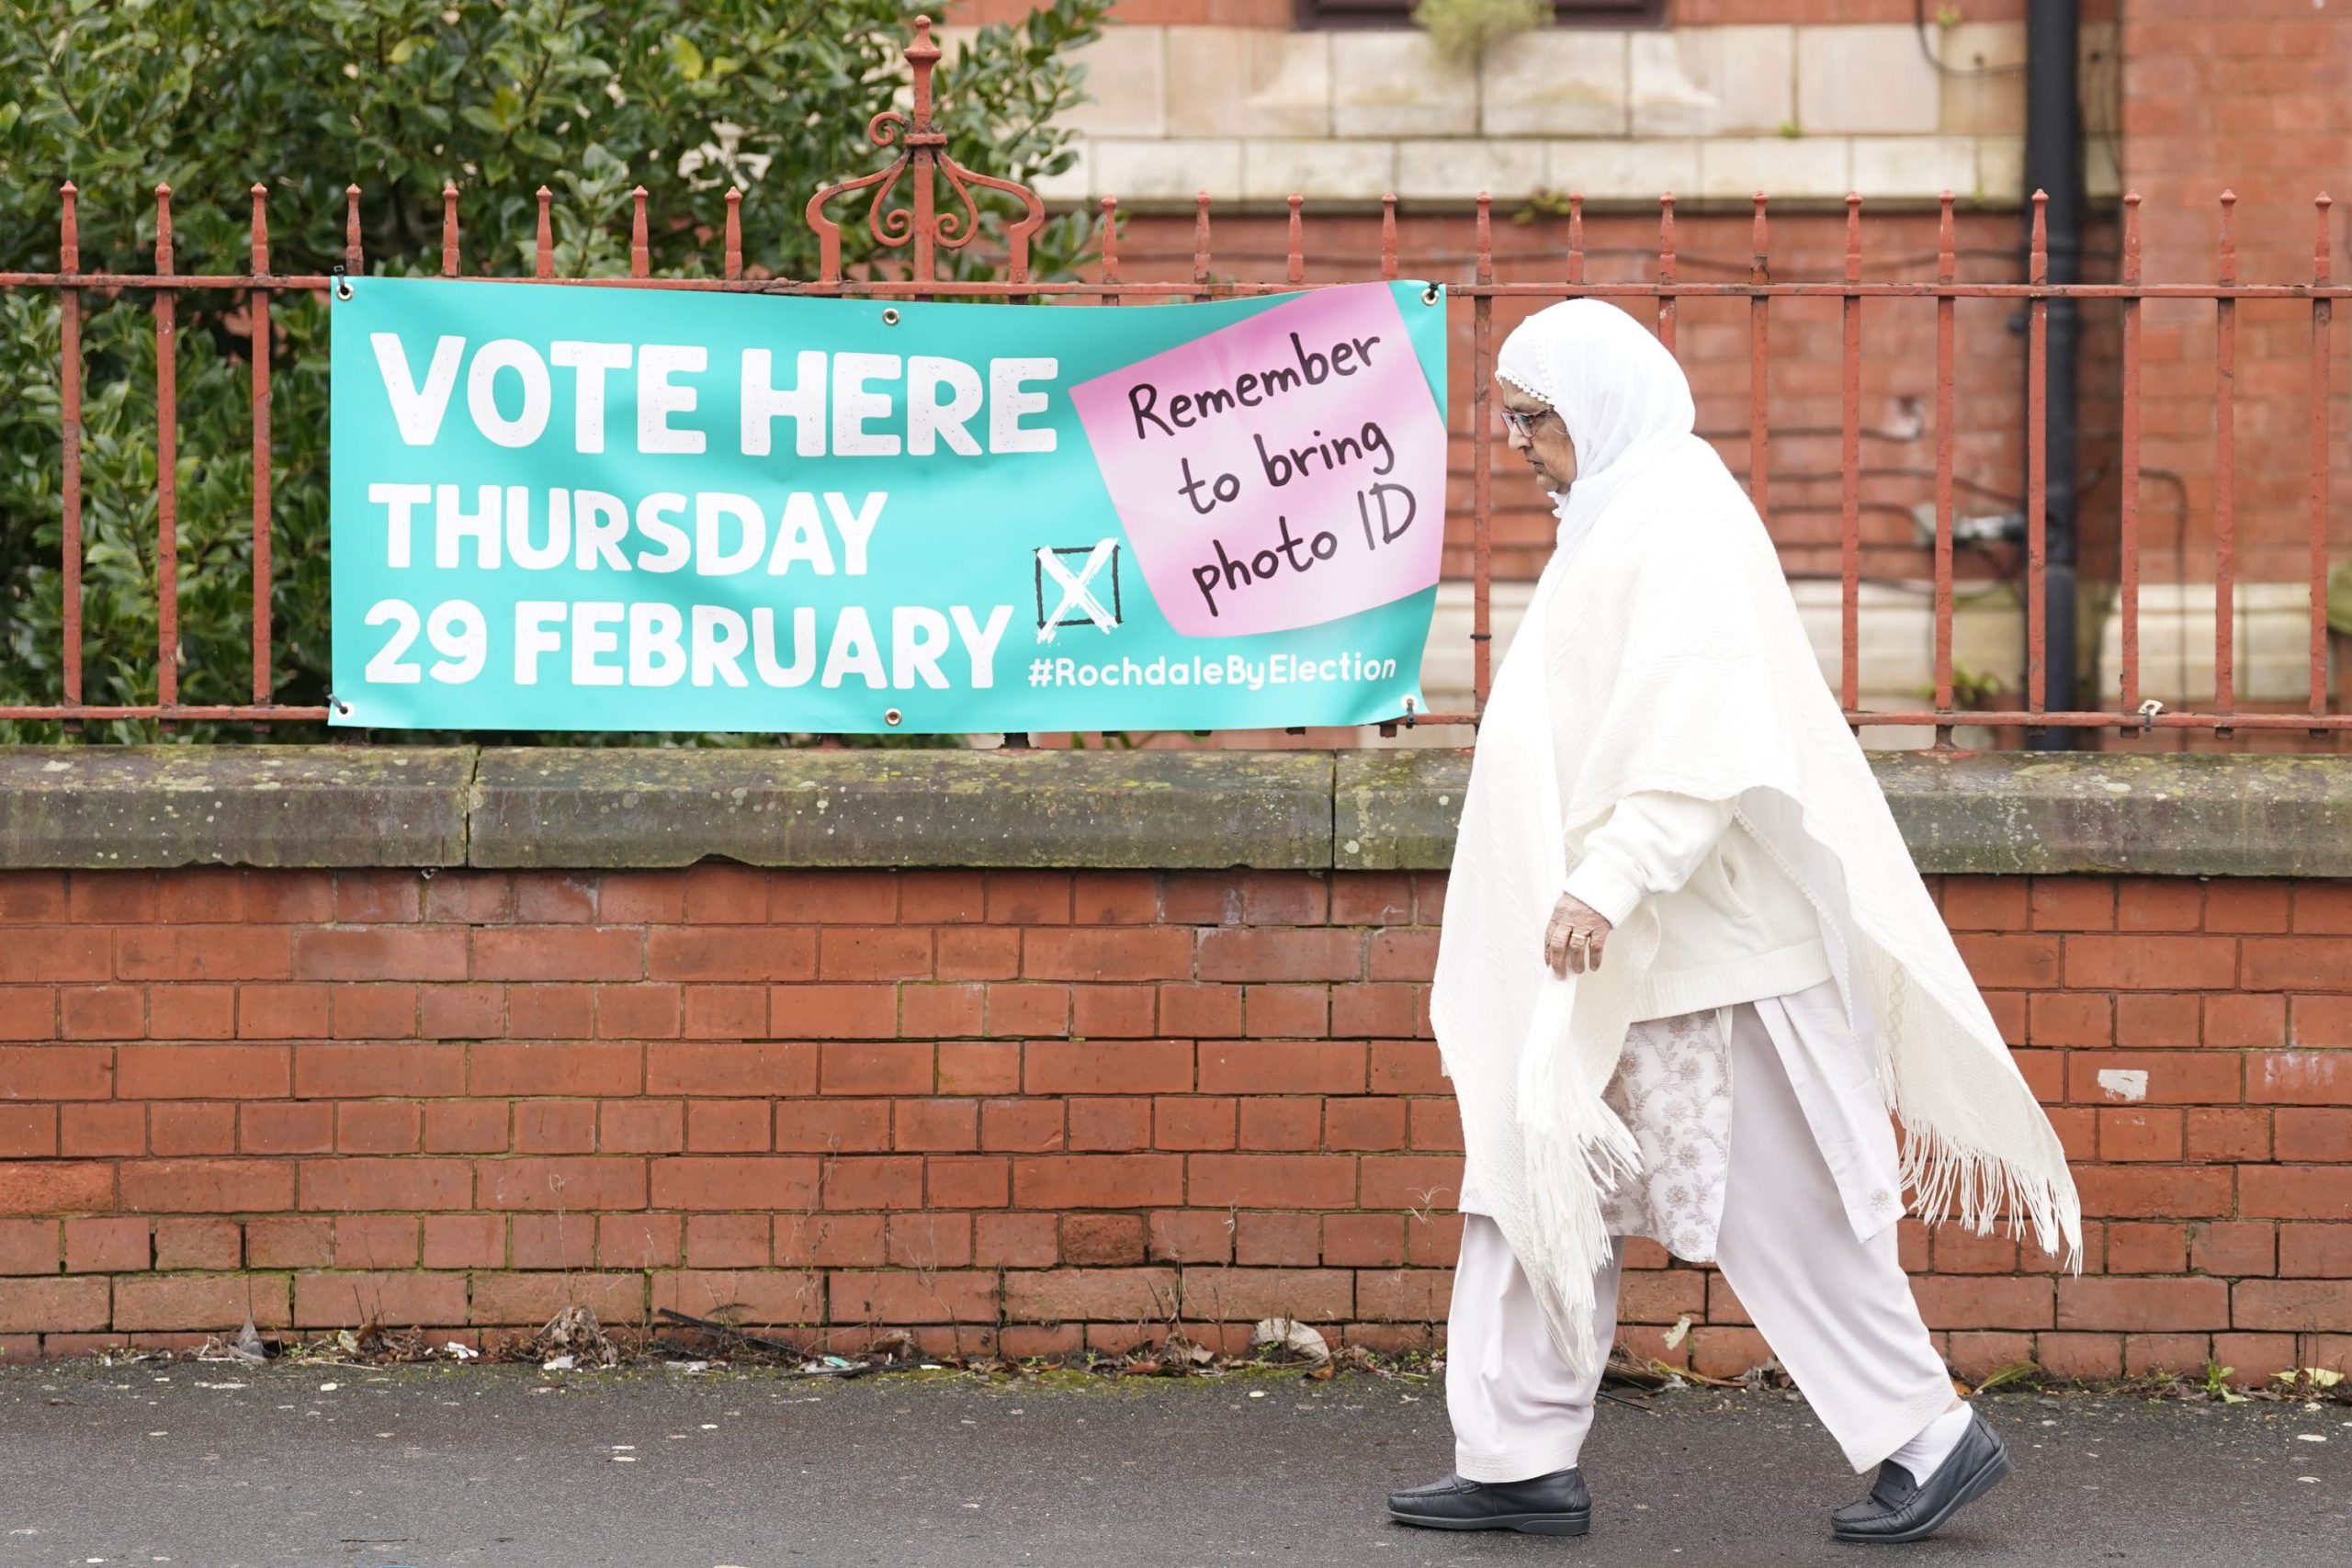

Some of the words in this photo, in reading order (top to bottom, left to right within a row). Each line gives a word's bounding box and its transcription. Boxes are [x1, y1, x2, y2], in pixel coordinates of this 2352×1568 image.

[370, 333, 707, 455] VOTE
[741, 348, 1058, 457] HERE
[1127, 332, 1381, 440] Remember
[1178, 457, 1240, 515] to
[1253, 422, 1395, 488] bring
[368, 482, 888, 577] THURSDAY
[1192, 515, 1338, 617] photo
[1357, 482, 1417, 551] ID
[364, 598, 488, 685] 29
[514, 600, 1015, 691] FEBRUARY
[1028, 651, 1396, 691] #RochdaleByElection
